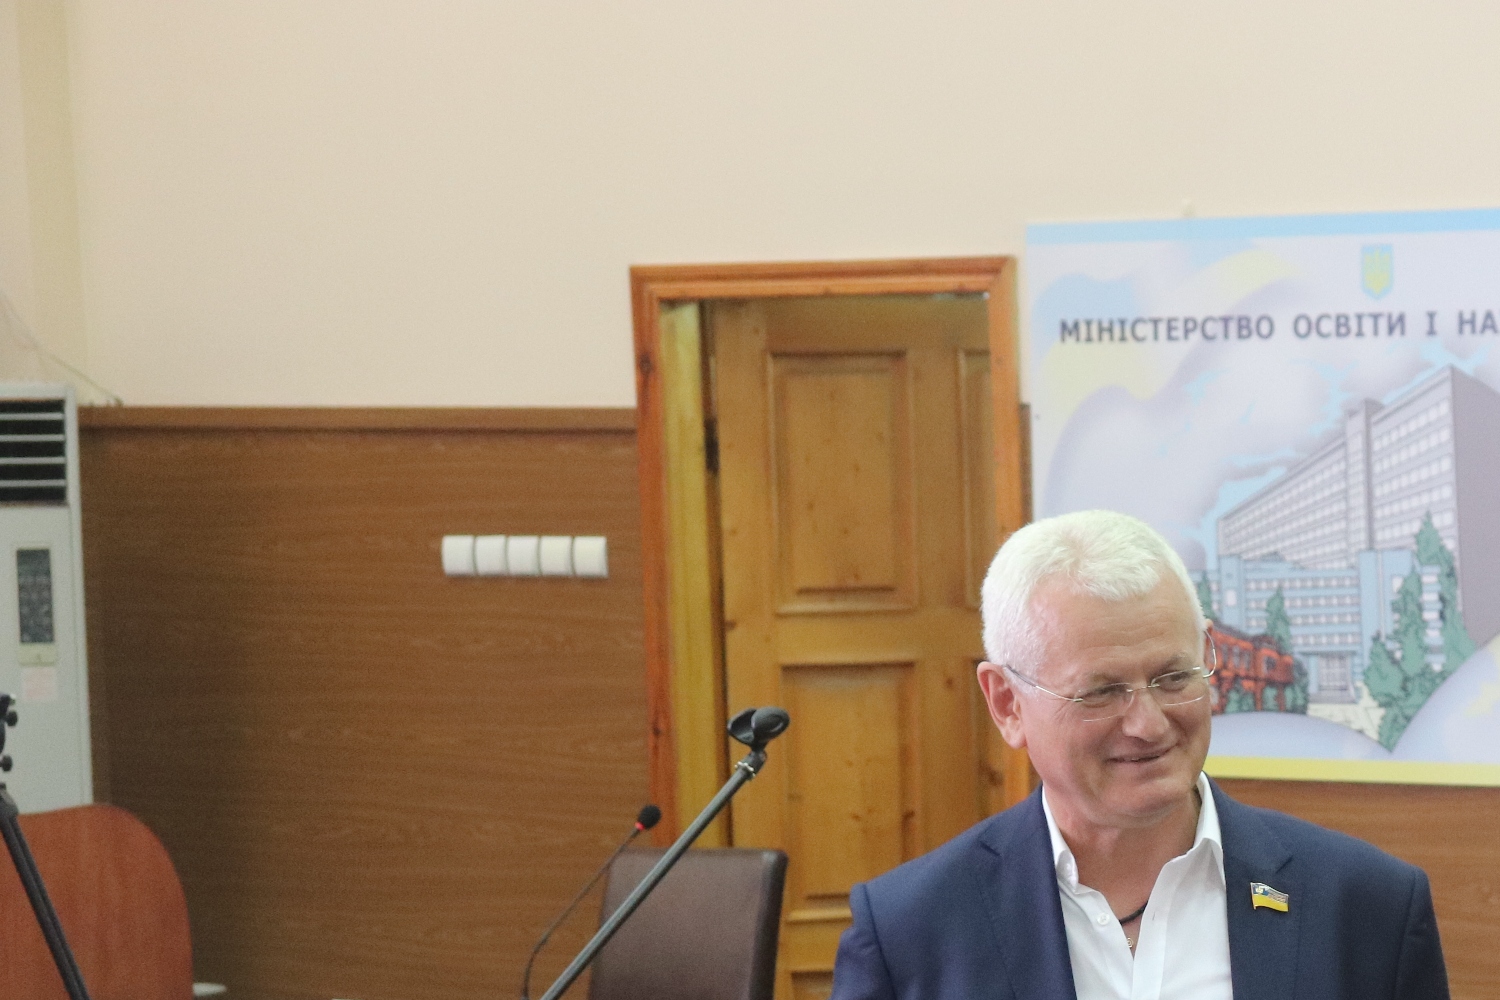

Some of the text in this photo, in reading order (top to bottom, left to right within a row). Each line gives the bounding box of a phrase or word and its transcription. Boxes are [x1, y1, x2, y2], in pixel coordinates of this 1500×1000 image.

[1059, 314, 1275, 344] МІНІСТЕРСТВО
[1292, 311, 1406, 339] ОСВІТИ
[1425, 310, 1438, 336] І
